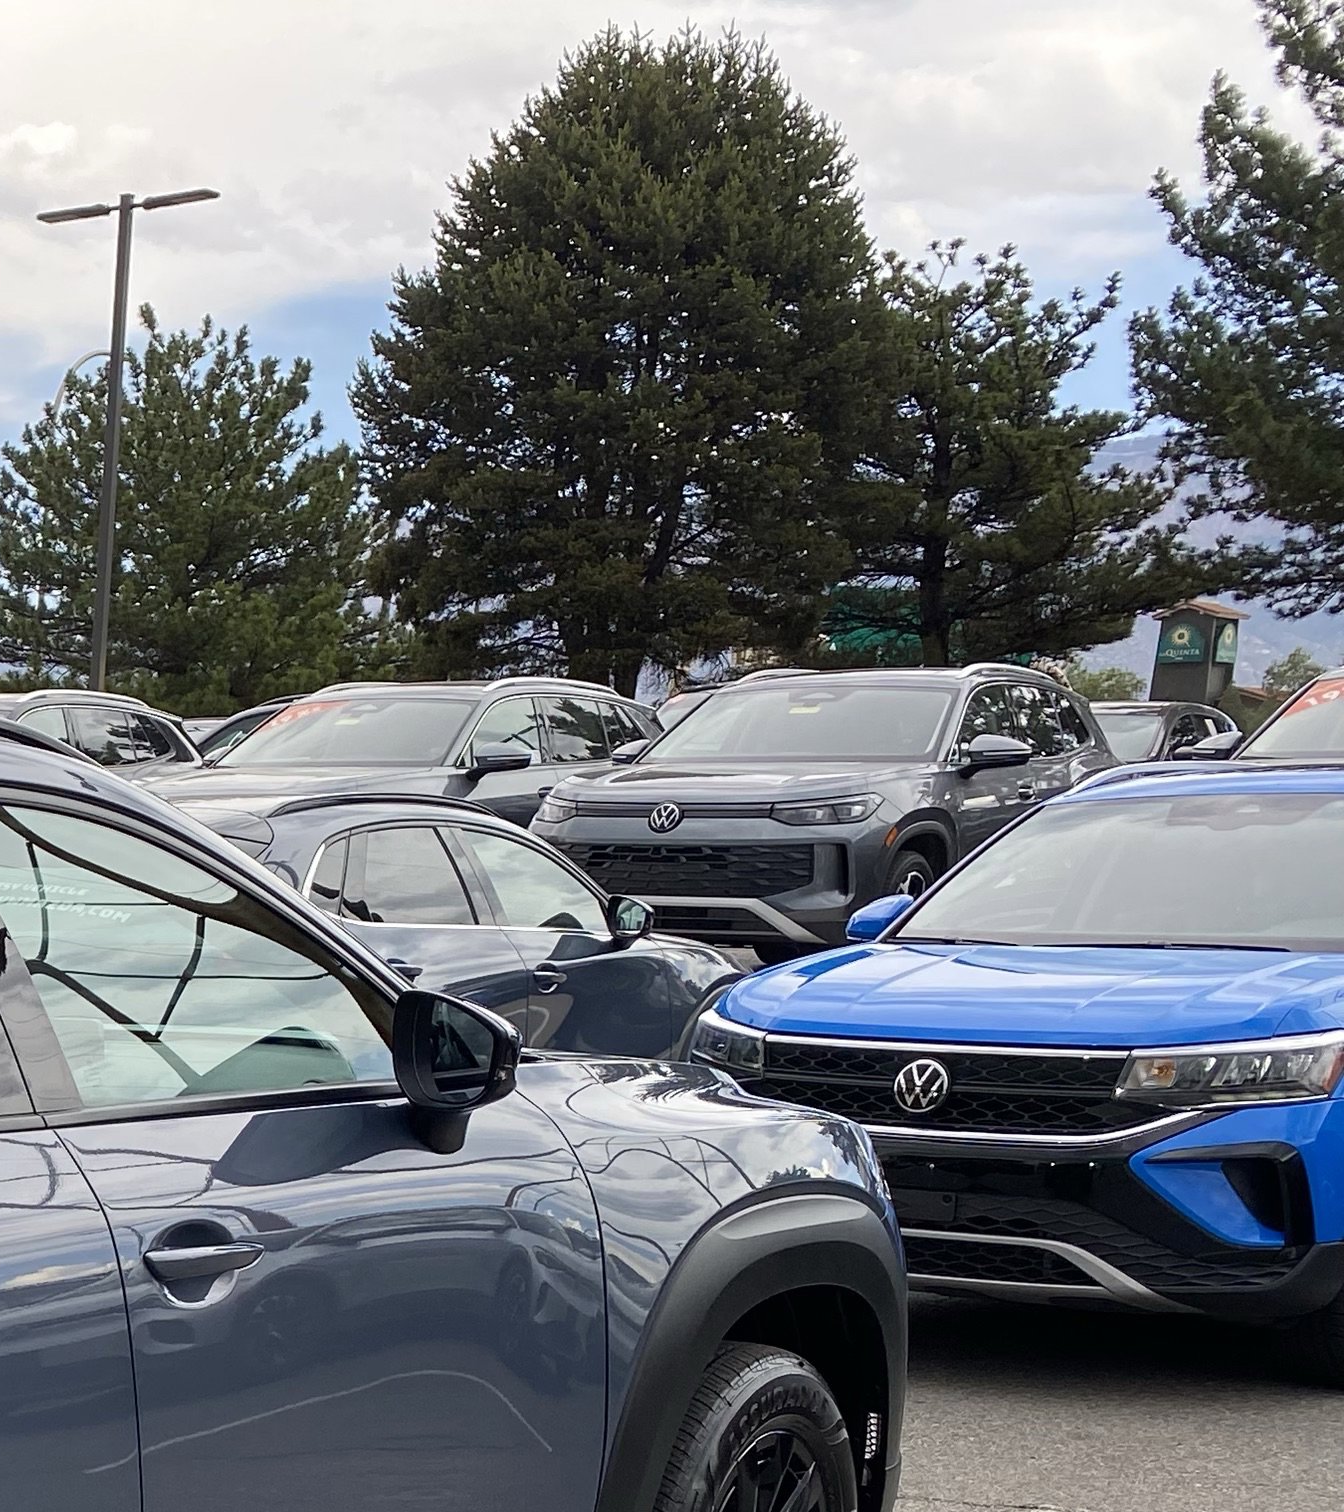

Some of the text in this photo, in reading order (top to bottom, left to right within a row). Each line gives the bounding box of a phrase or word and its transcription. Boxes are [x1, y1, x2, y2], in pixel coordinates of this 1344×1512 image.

[1165, 648, 1200, 658] QUINTA
[650, 803, 679, 831] VW
[894, 1058, 948, 1113] VW
